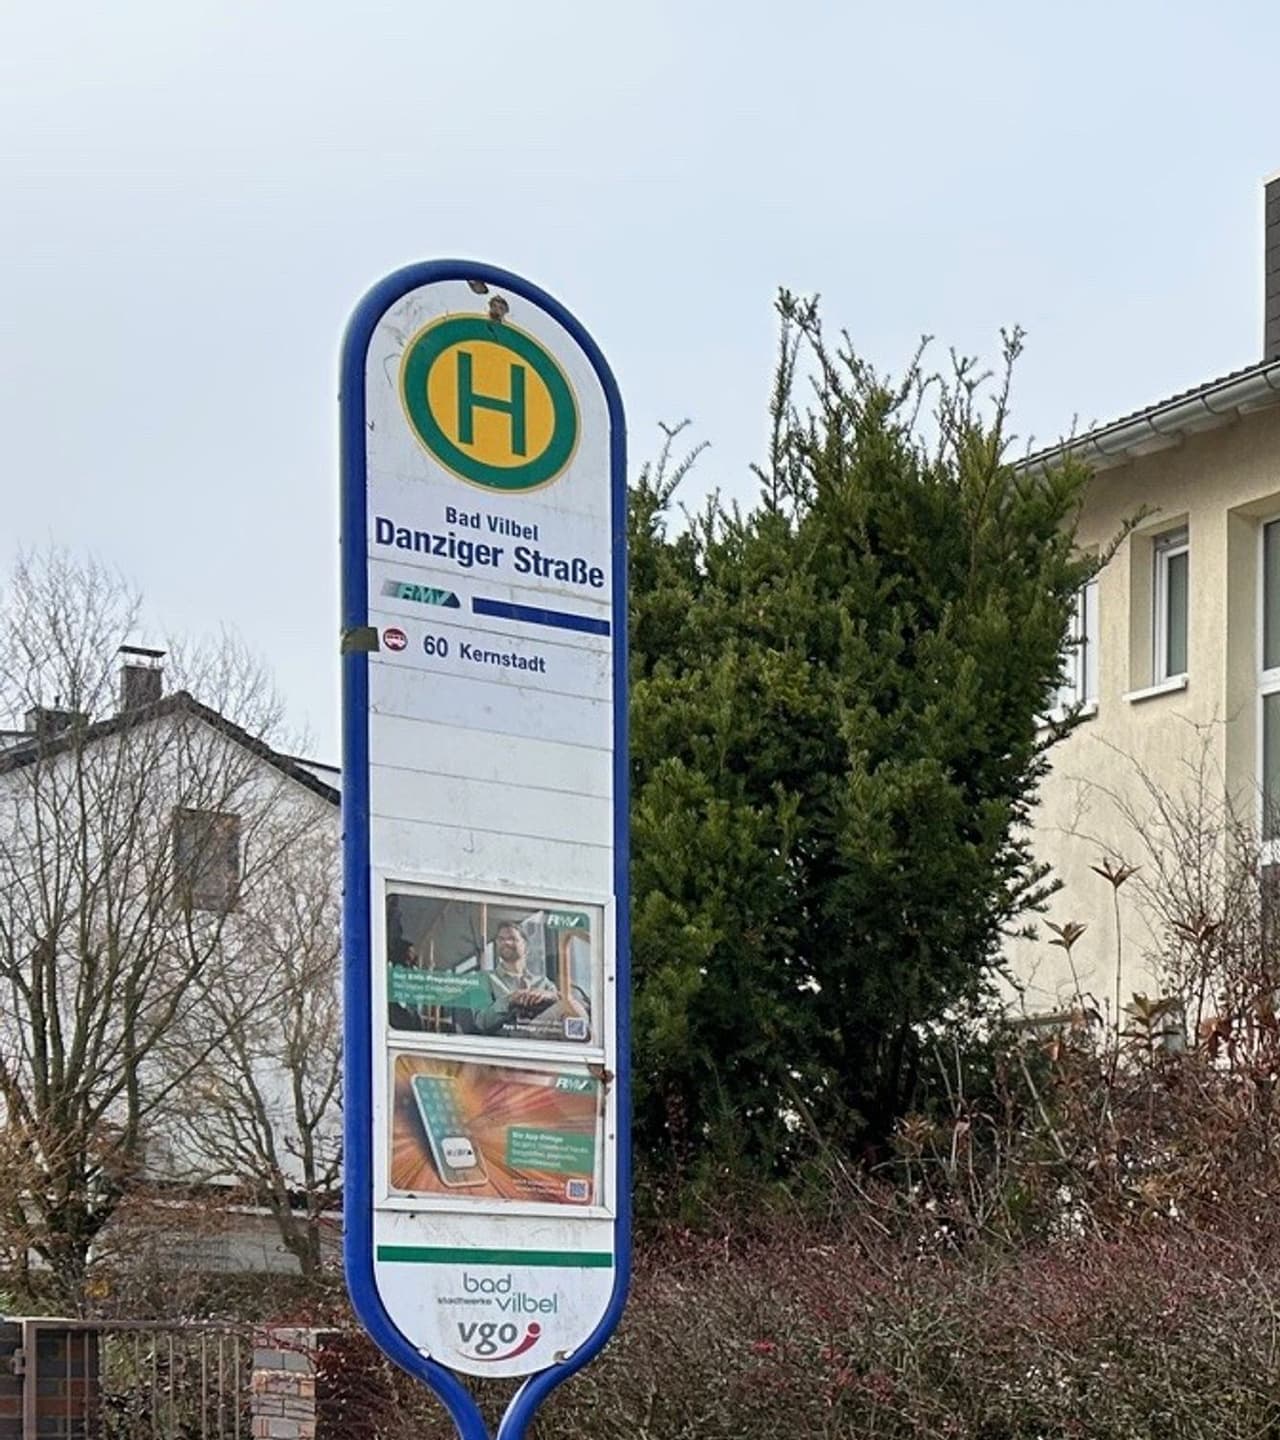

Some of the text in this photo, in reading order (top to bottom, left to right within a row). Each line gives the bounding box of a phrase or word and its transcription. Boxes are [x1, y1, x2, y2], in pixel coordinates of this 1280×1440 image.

[457, 351, 527, 457] H
[445, 505, 539, 542] Bad Vilbel
[375, 517, 605, 588] Danziger Straße
[424, 635, 546, 674] 60 Kernstadt
[463, 1272, 512, 1293] bad
[495, 1292, 557, 1313] vilbel
[458, 1322, 518, 1355] vgo
